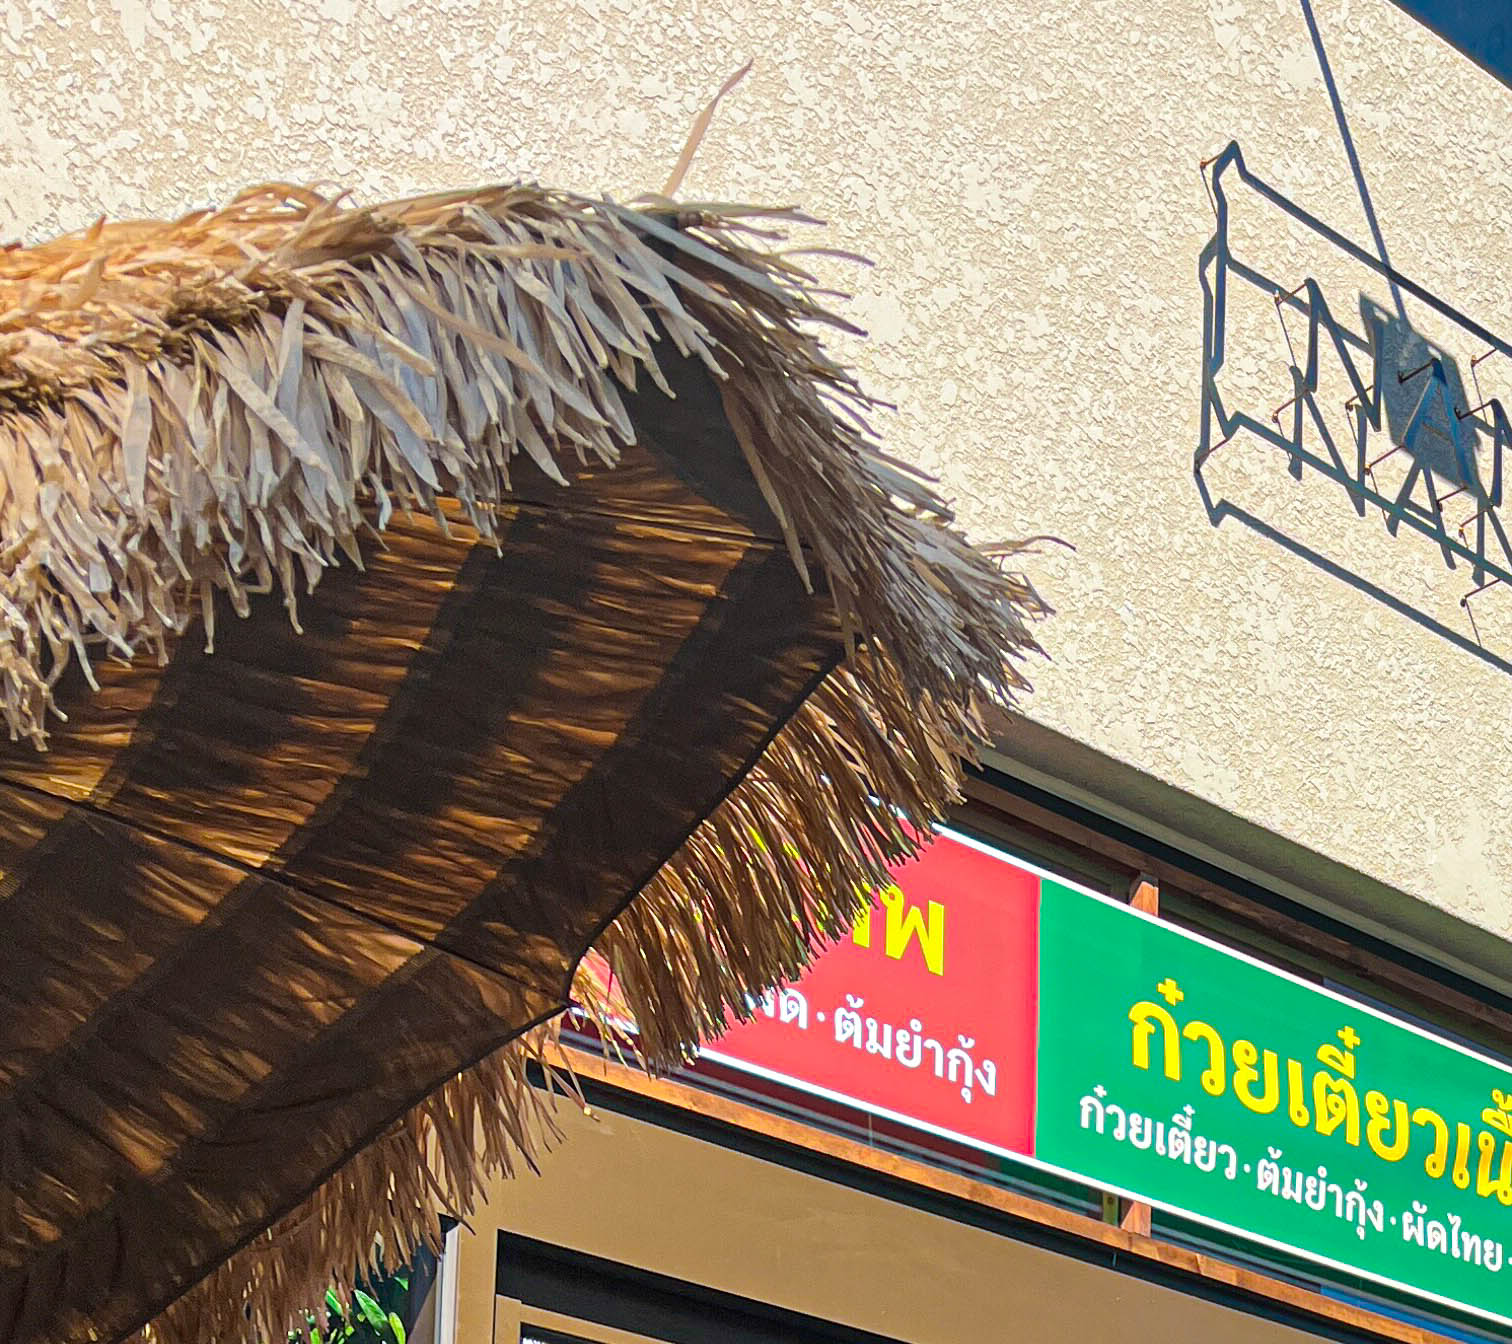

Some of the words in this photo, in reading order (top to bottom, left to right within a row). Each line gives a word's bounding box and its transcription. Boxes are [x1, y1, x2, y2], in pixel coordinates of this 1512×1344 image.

[834, 994, 997, 1104] ต้มยำกุ้ง
[1256, 1146, 1385, 1240] ต้มยำกุ้ง
[1402, 1201, 1503, 1271] ผัดไทย
